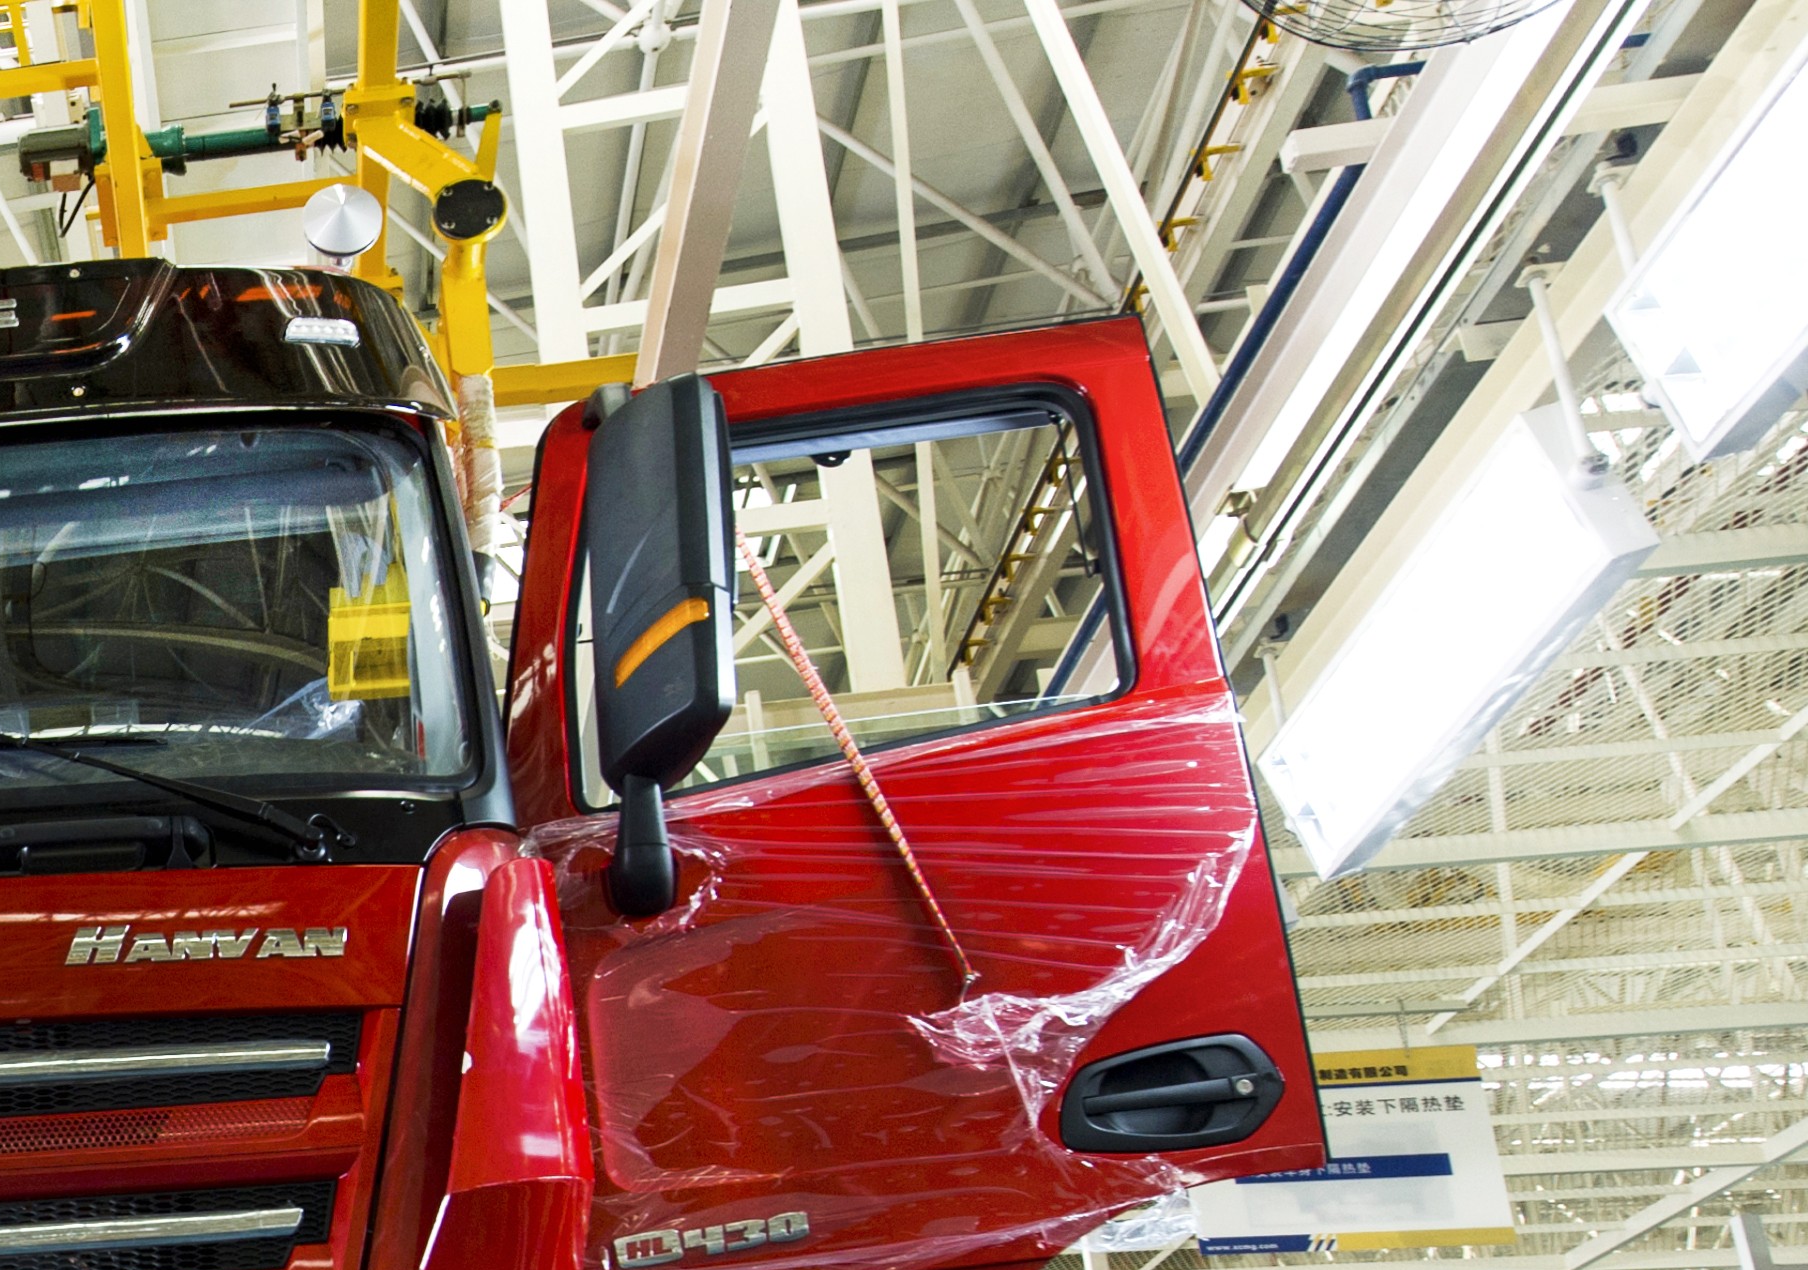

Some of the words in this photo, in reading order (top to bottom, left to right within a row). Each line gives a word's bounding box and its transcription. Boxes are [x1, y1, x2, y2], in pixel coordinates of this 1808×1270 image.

[64, 925, 348, 965] HANVAN
[1322, 1095, 1466, 1117] :安装下隔热垫
